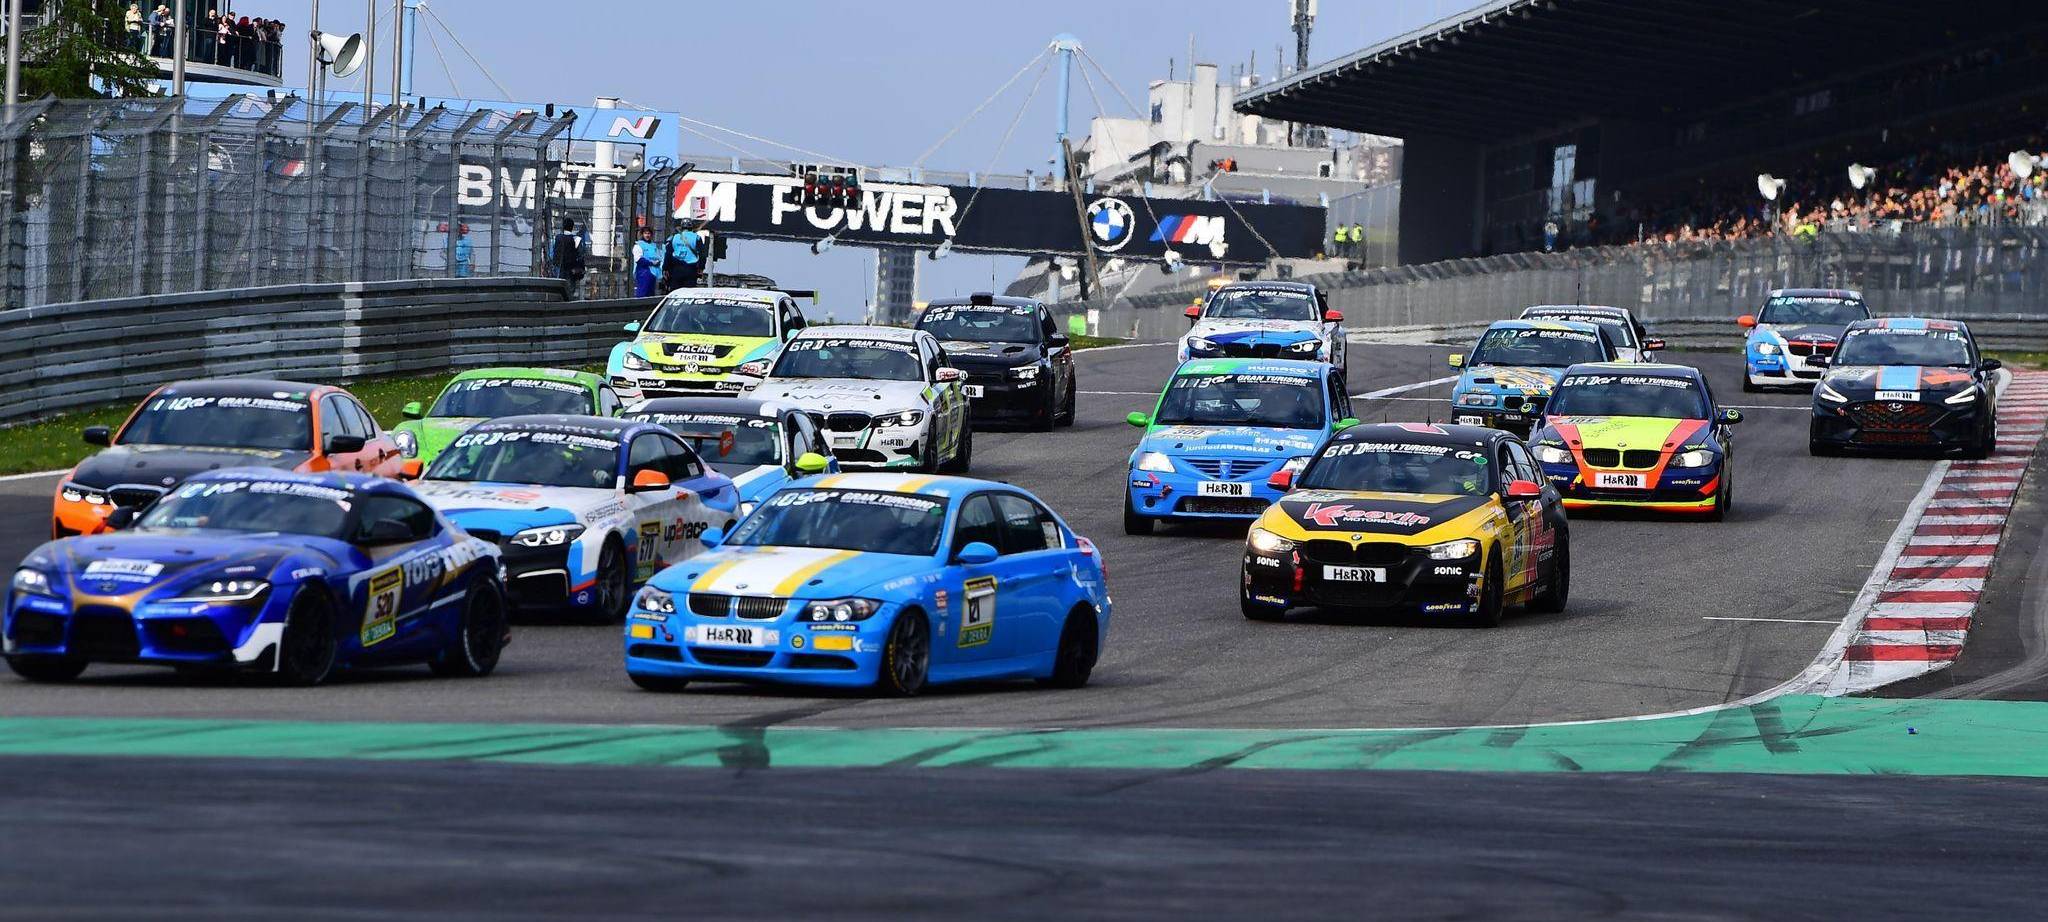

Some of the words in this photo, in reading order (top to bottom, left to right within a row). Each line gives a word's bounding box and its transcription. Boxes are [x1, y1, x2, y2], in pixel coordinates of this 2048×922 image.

[848, 340, 875, 348] GRAN
[1620, 376, 1647, 385] GRAN
[1366, 443, 1398, 451] GRAN
[1398, 444, 1448, 454] TURISMO
[1343, 517, 1415, 527] MOTORSPORT
[1333, 568, 1359, 580] H&R
[1426, 603, 1462, 611] GOODYEAR
[706, 627, 734, 641] H&R
